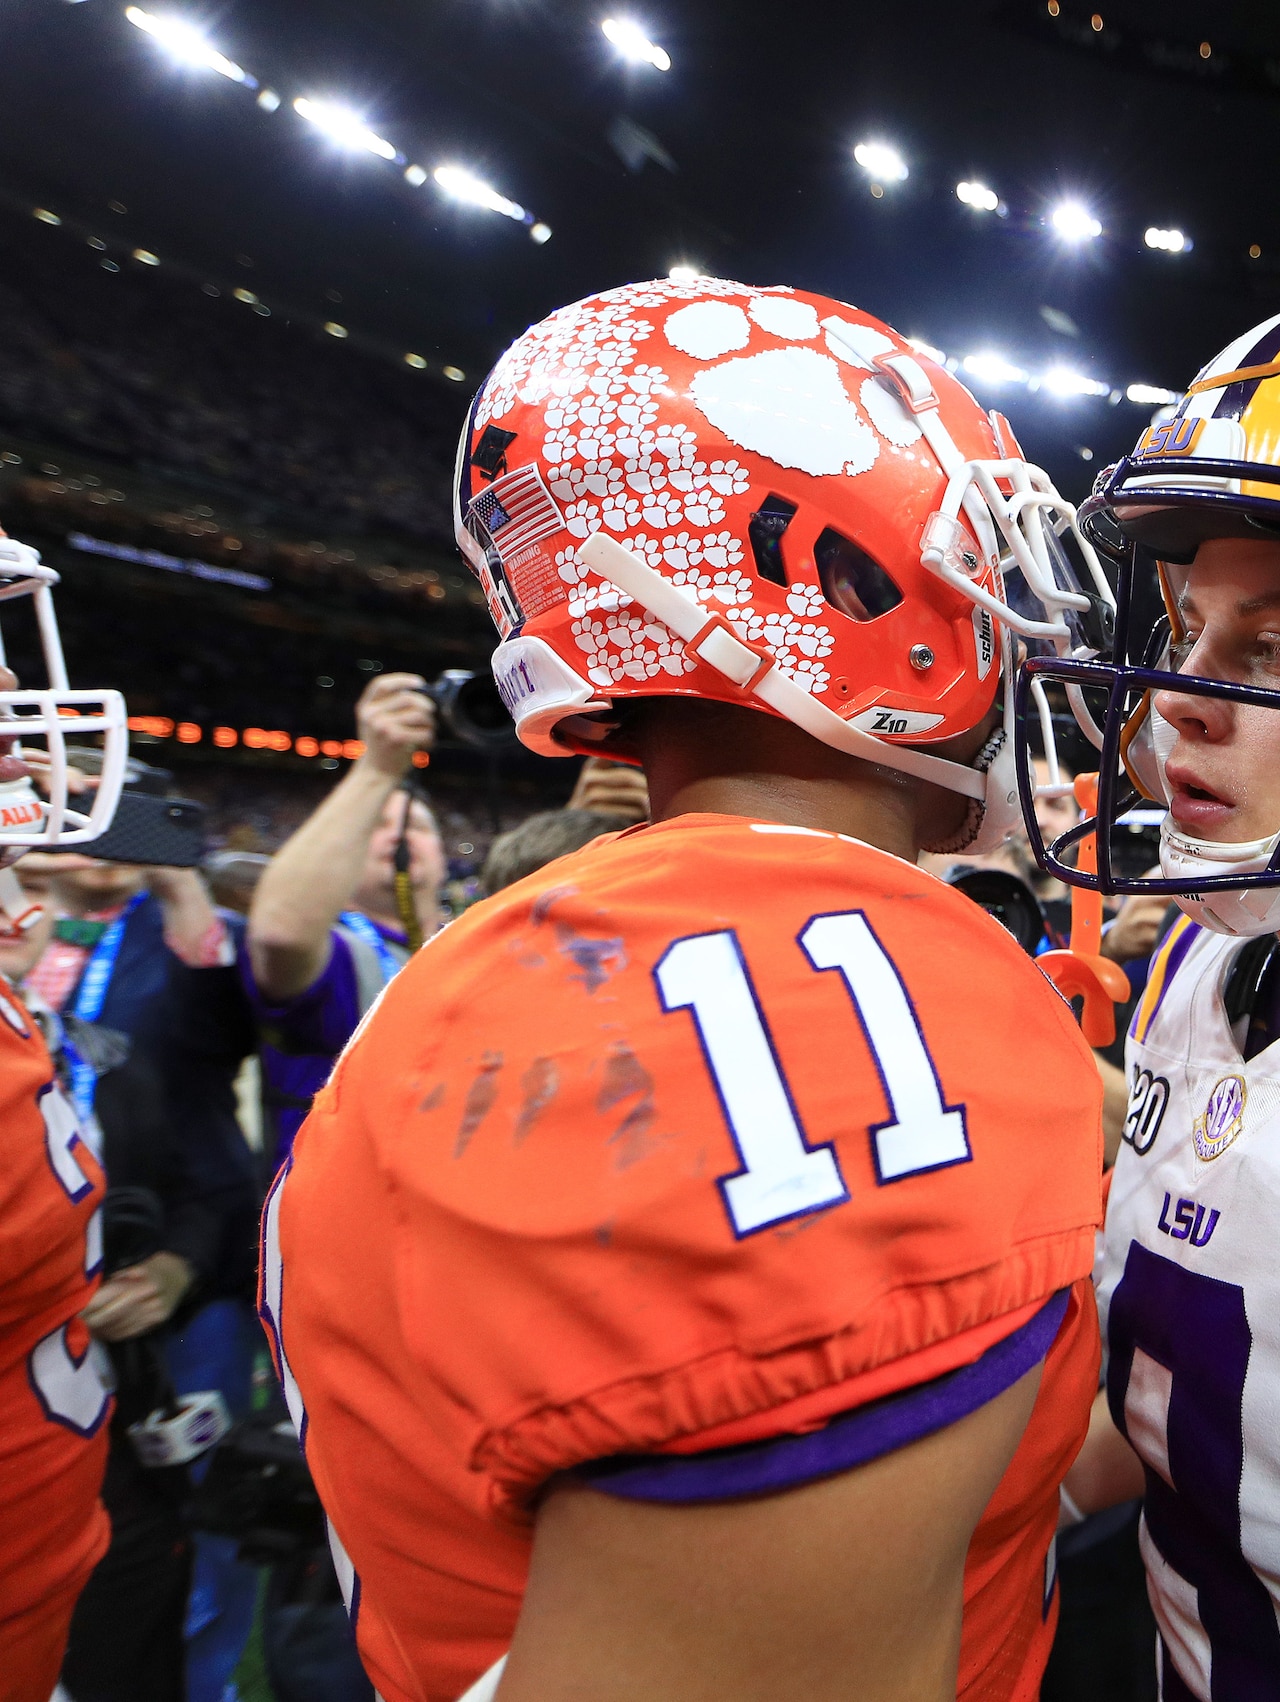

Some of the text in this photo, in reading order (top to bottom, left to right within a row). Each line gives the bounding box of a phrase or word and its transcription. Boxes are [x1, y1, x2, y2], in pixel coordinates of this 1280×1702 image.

[1133, 417, 1206, 457] LSU
[507, 544, 541, 571] WARNING
[871, 712, 908, 733] Z10
[1, 805, 33, 827] ALL
[650, 908, 974, 1242] 11
[1121, 1069, 1171, 1157] 20
[1157, 1191, 1221, 1247] LSU
